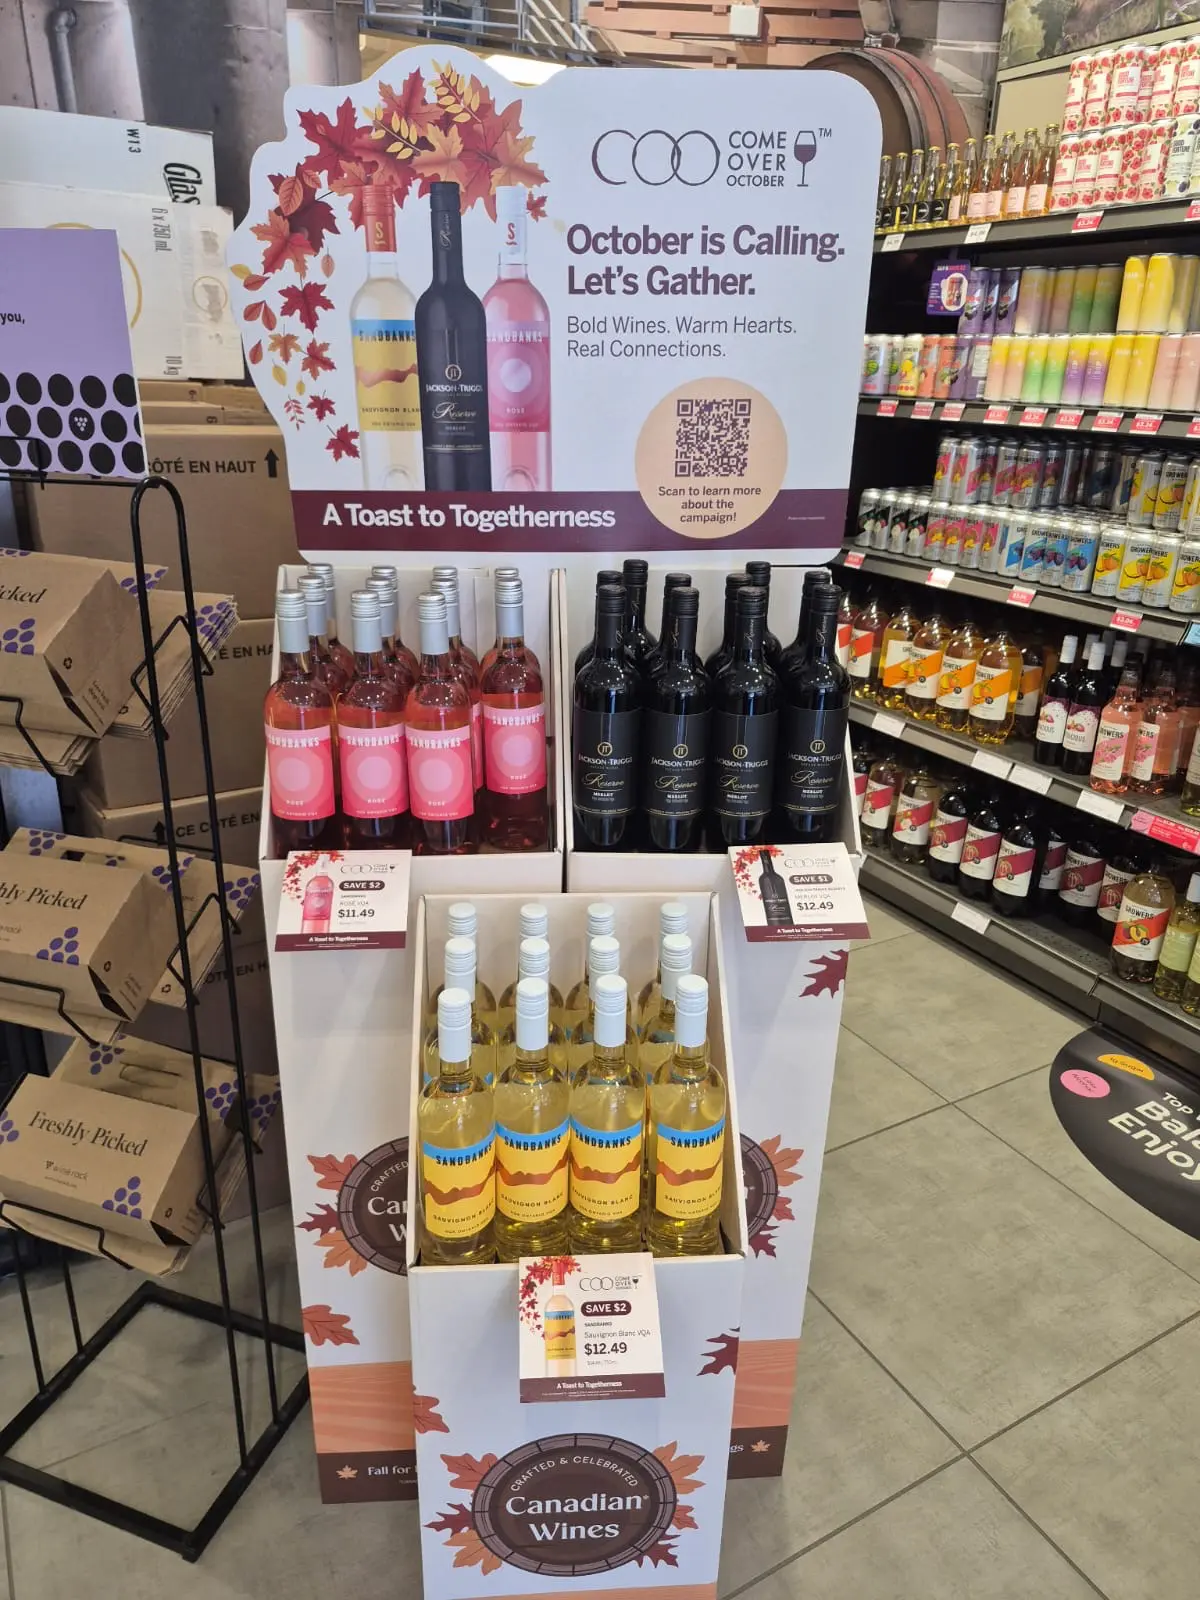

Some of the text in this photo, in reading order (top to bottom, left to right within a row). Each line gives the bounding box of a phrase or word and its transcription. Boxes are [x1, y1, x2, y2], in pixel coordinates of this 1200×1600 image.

[728, 130, 788, 149] COME
[727, 152, 787, 172] OVER
[726, 174, 785, 188] OCTOBER
[153, 224, 171, 238] 750
[566, 223, 846, 263] October is Calling.
[567, 265, 756, 296] Let’s Gather.
[0, 312, 26, 325] you,
[566, 316, 797, 334] Bold Wines. Warm Hearts.
[566, 340, 727, 358] Real Connections.
[163, 355, 182, 376] 10 kg
[189, 460, 211, 474] EN
[215, 460, 257, 474] HAUT
[658, 485, 762, 497] Scan to learn more
[681, 498, 735, 510] about the
[322, 503, 617, 533] A Toast to Togetherness
[679, 512, 737, 525] campaign!
[232, 645, 252, 659] EN
[175, 824, 196, 838] CE
[199, 814, 238, 833] CTÉ
[368, 881, 381, 889] $2
[24, 887, 88, 910] Picked
[796, 901, 834, 911] $12.49
[338, 908, 375, 919] $11.49
[1125, 904, 1154, 920] GROWERS
[1162, 1091, 1194, 1114] Top
[28, 1110, 149, 1157] Freshly Picked
[503, 1133, 562, 1152] SANDBANKS
[435, 1140, 493, 1167] SANDBANKS
[500, 1193, 542, 1208] SAUVIGNON
[432, 1213, 477, 1224] SAUVIGNON
[585, 1303, 627, 1313] SAVE $2
[584, 1341, 628, 1356] $12.49
[562, 1381, 578, 1389] Toast
[367, 1464, 412, 1476] Fall for
[510, 1455, 639, 1492] CRAFTED & CELEBRATED
[505, 1493, 643, 1516] Canadian
[528, 1521, 620, 1542] Wines
